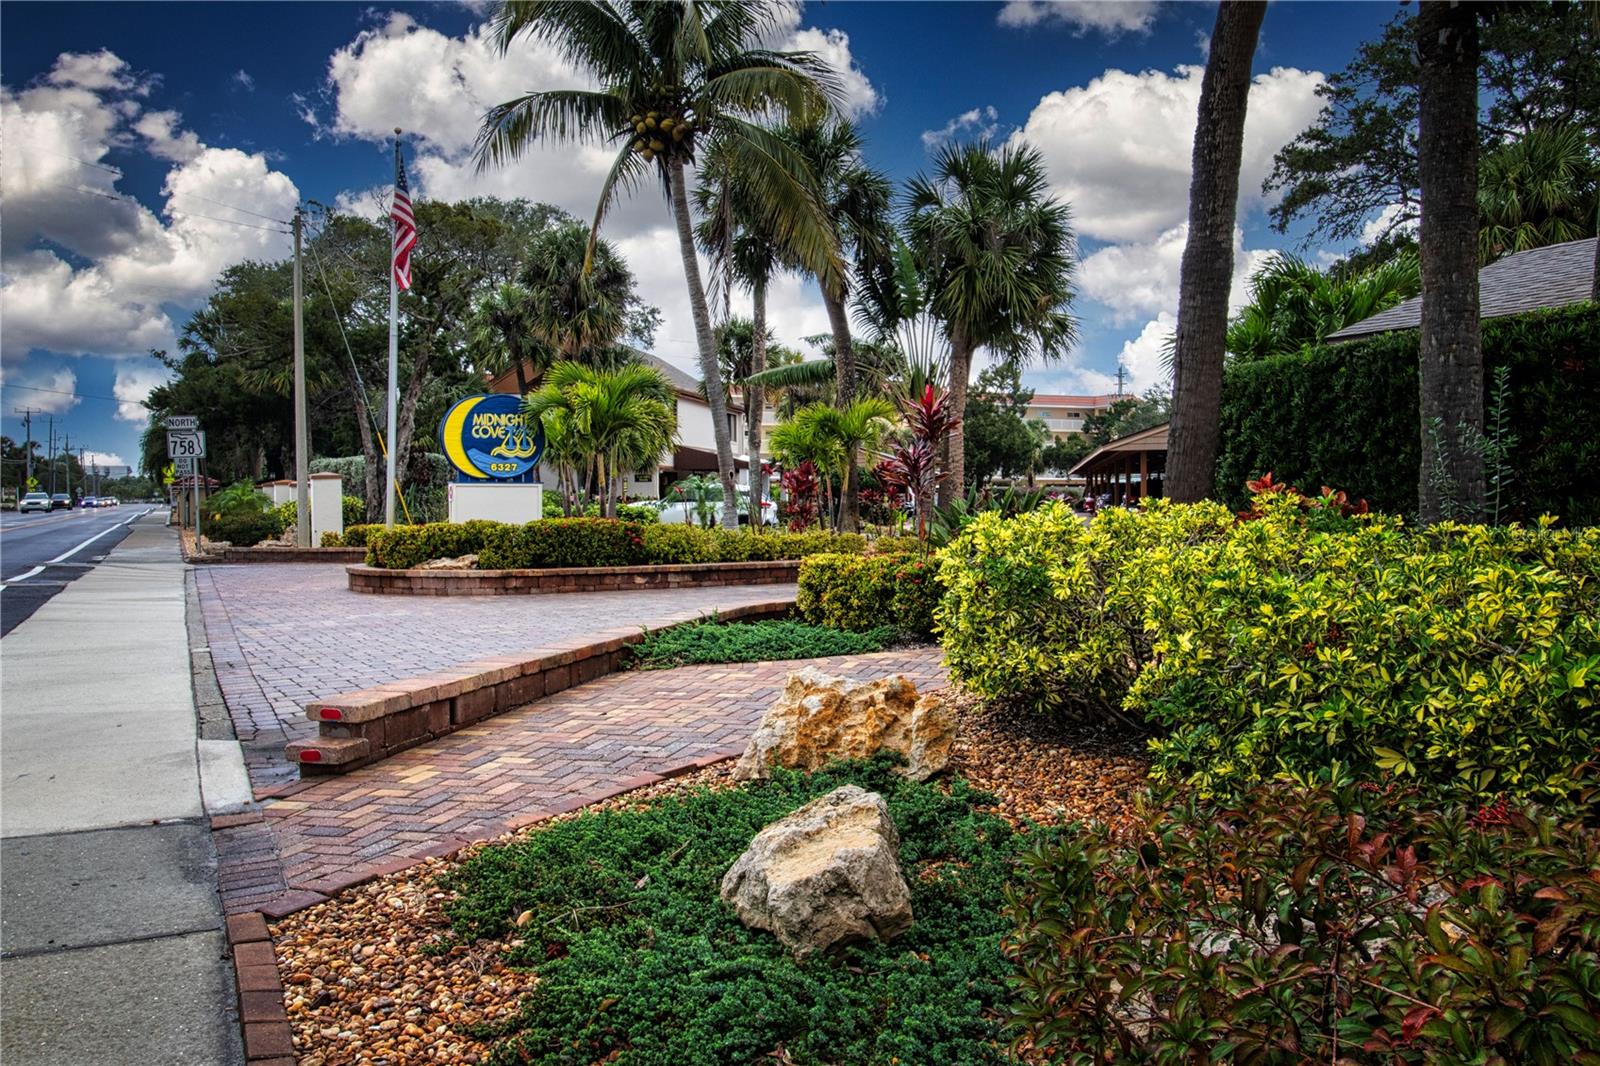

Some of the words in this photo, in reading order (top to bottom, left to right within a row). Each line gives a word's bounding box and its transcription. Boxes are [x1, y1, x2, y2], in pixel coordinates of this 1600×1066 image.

[169, 419, 195, 427] NORTH
[472, 425, 505, 439] COVE
[170, 440, 195, 455] 758
[490, 463, 517, 471] 6327
